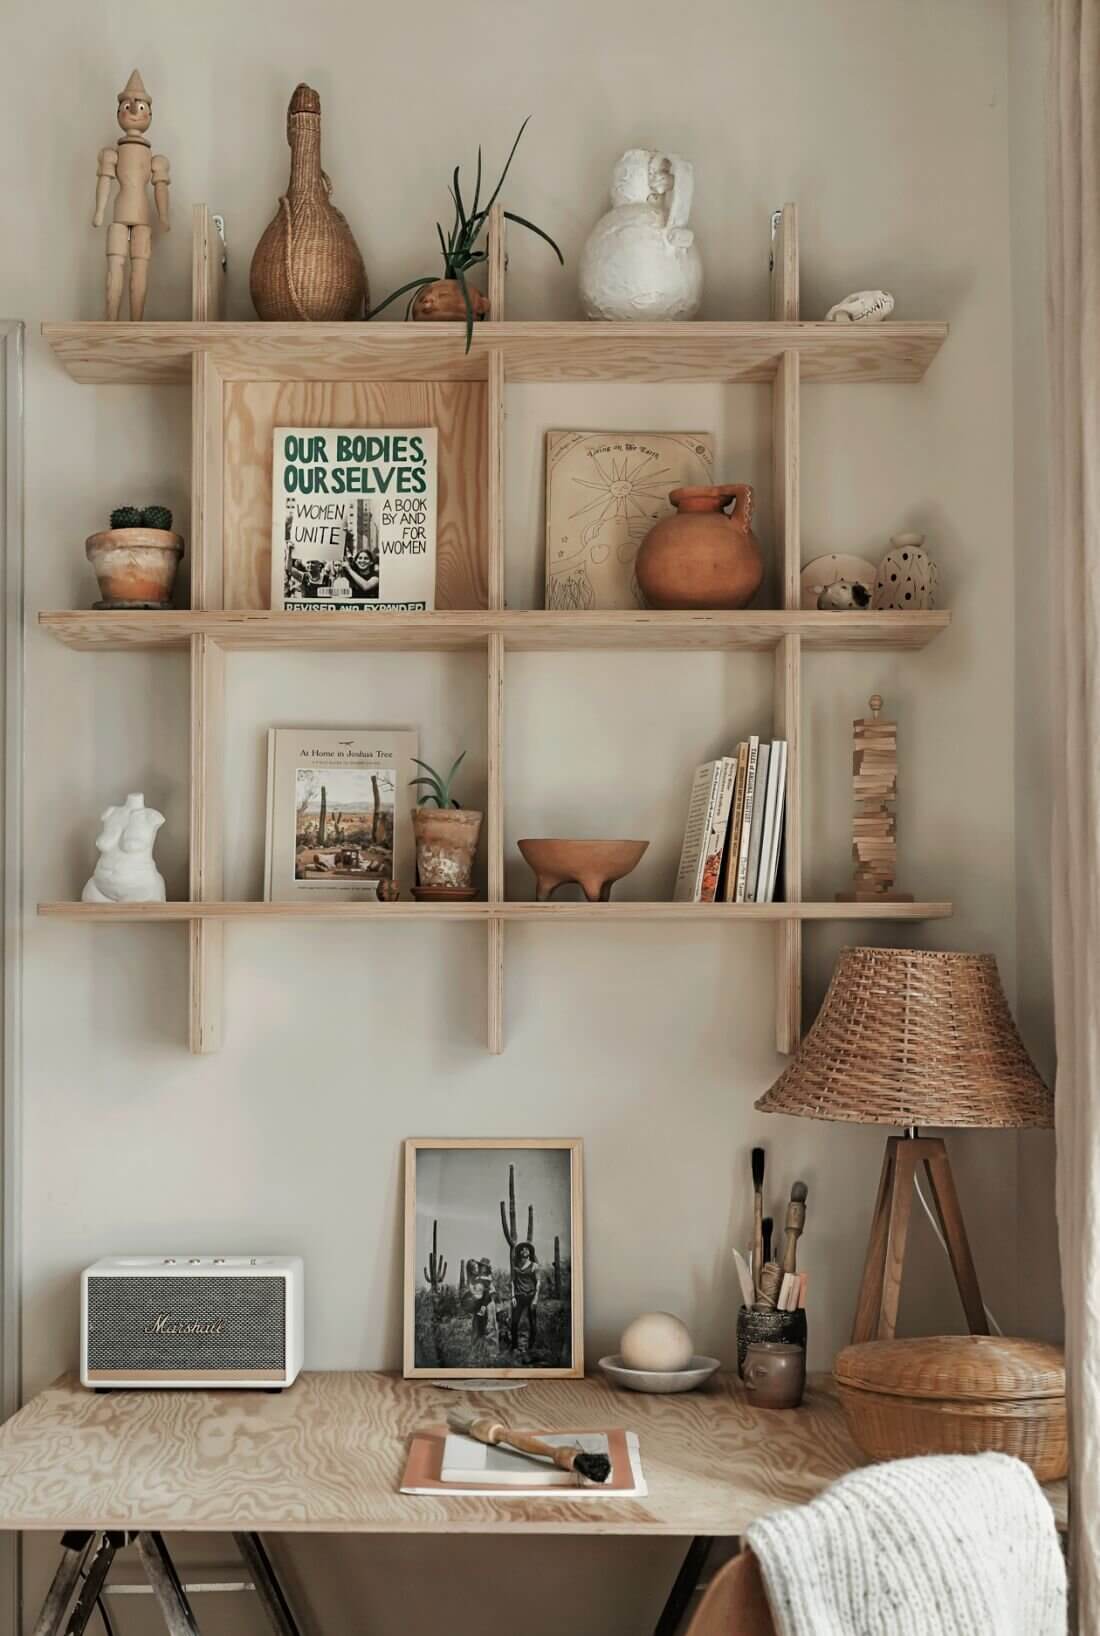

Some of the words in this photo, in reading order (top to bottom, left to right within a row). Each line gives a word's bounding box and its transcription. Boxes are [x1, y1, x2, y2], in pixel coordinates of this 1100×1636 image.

[284, 435, 328, 463] OUR
[336, 435, 427, 467] BODIES,
[284, 465, 427, 494] OURSELVES
[296, 504, 345, 520] WOMEN
[382, 499, 392, 512] A
[395, 497, 428, 512] BOOK
[382, 513, 398, 526] BY
[399, 512, 426, 525] AND
[294, 526, 341, 545] UNITE
[402, 527, 426, 539] FOR
[381, 541, 426, 555] WOMEN
[299, 749, 309, 757] At
[311, 749, 335, 757] Home
[346, 750, 374, 758] Joshua
[376, 750, 393, 758] Tree
[144, 1312, 225, 1334] Marshall
